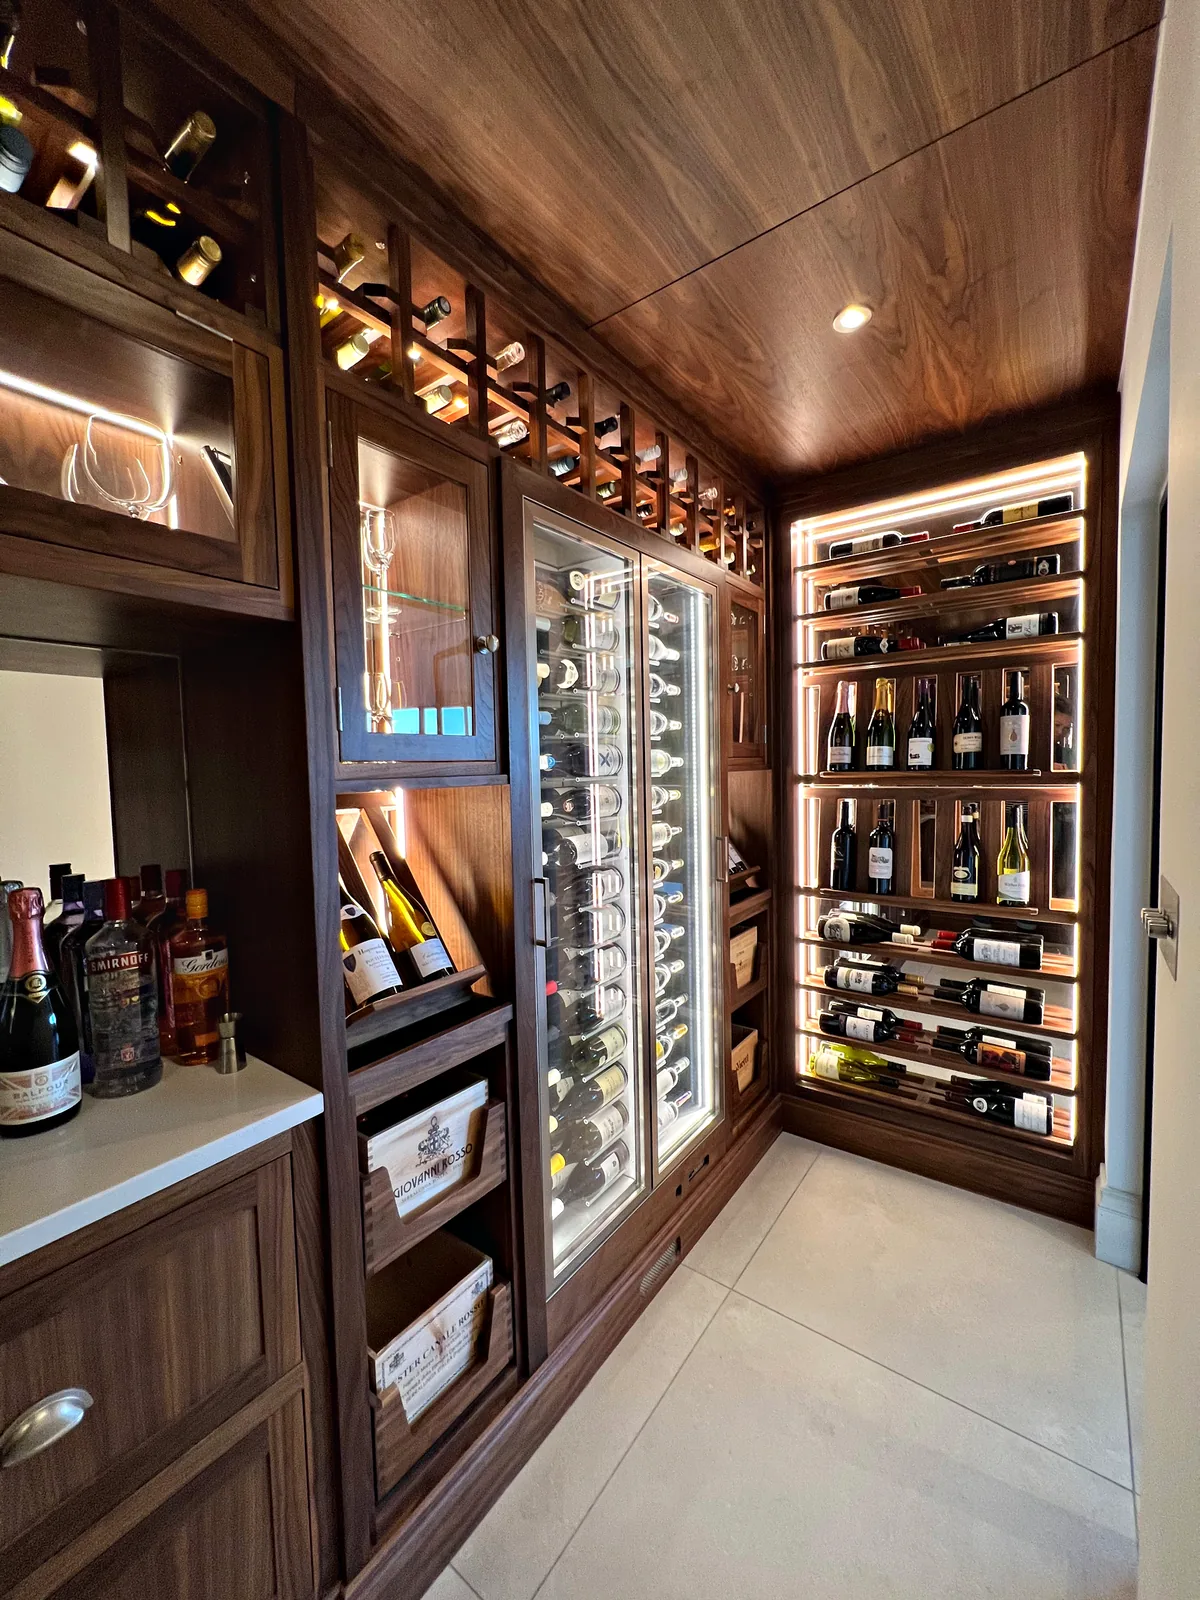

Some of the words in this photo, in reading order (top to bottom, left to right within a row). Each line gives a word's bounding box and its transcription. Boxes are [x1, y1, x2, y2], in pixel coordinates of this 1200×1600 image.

[91, 953, 148, 971] SMIRNOFF
[13, 1079, 68, 1099] BALFOUR
[393, 1160, 440, 1198] GIOVANNI
[442, 1143, 473, 1168] ROSSO
[397, 1357, 420, 1383] STER
[458, 1298, 484, 1328] ROSSO
